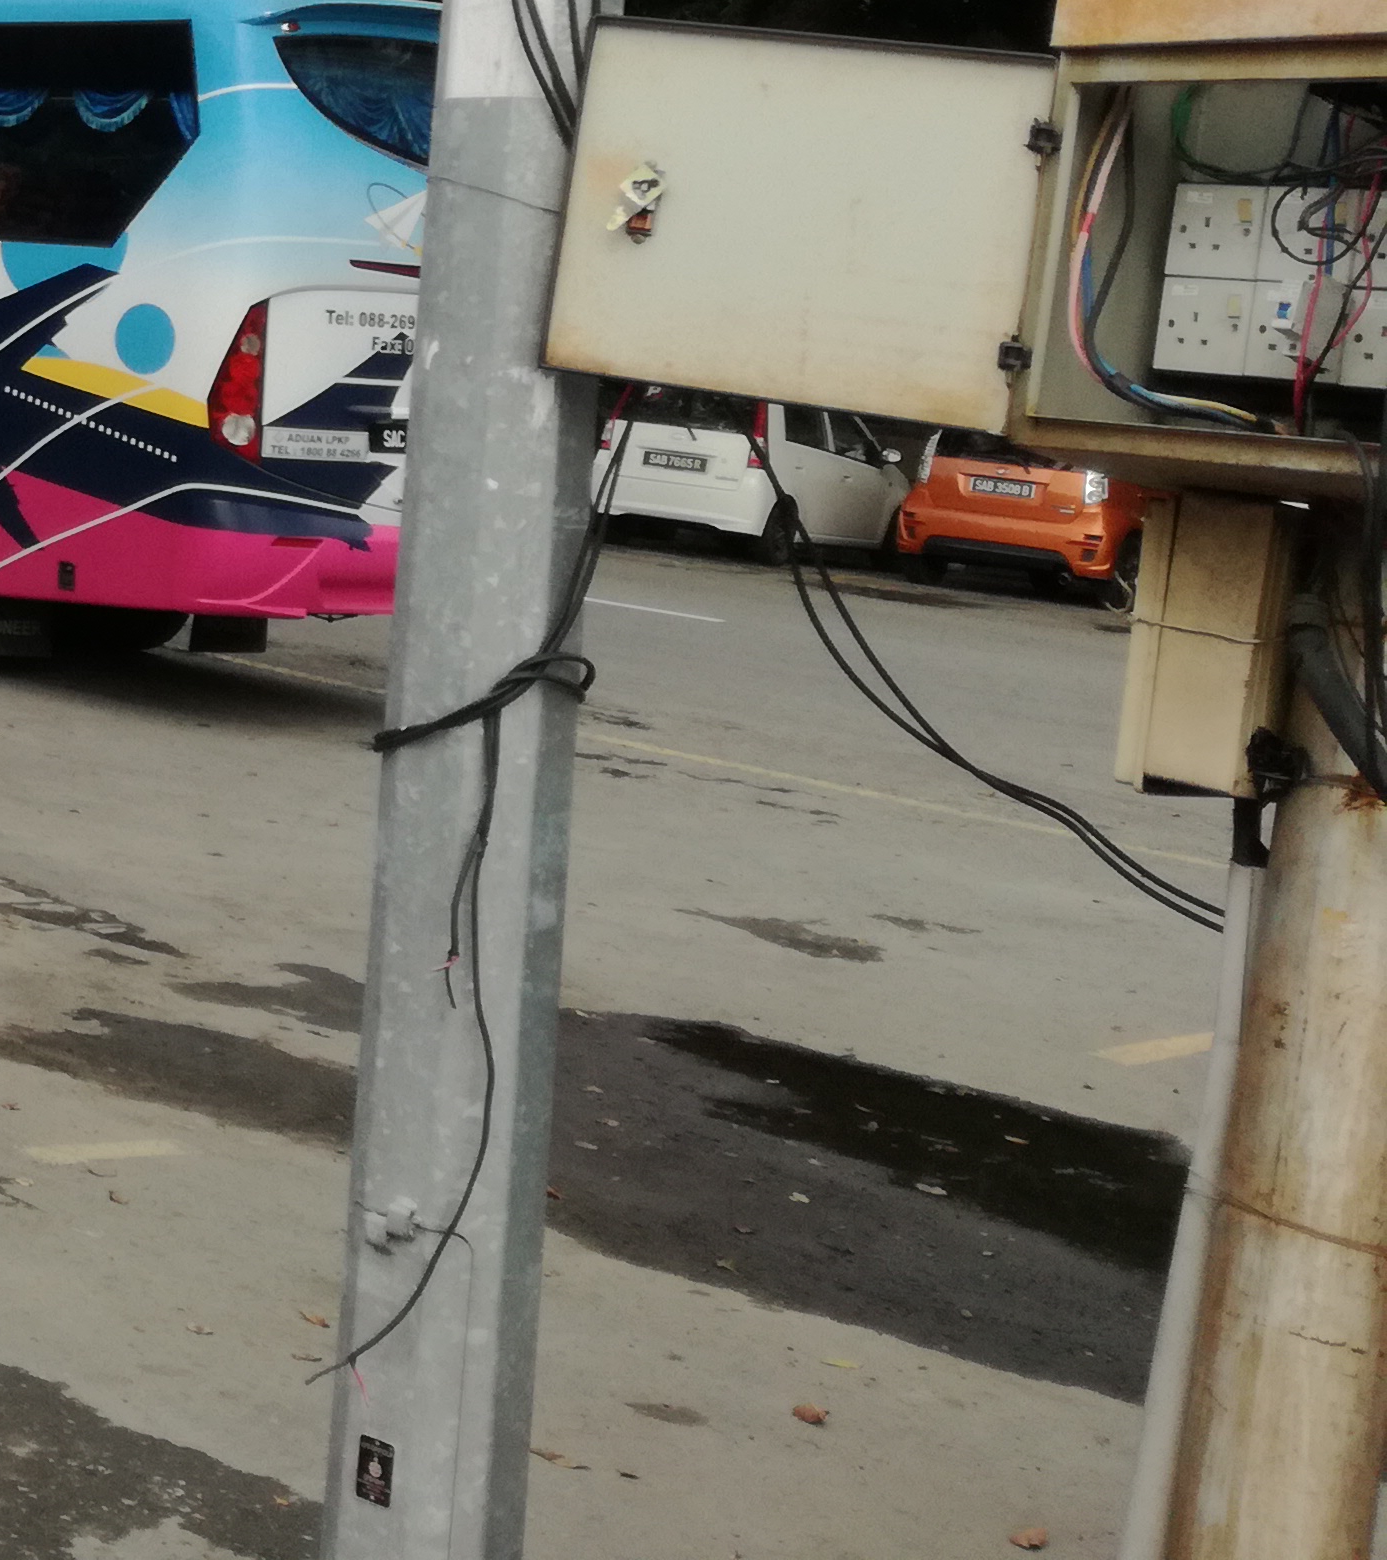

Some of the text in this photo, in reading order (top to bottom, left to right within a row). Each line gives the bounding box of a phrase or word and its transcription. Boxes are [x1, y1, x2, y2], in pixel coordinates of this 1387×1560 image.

[326, 310, 354, 326] Tel:
[383, 429, 406, 448] SAC
[270, 445, 290, 455] TEL
[975, 479, 995, 492] SAB
